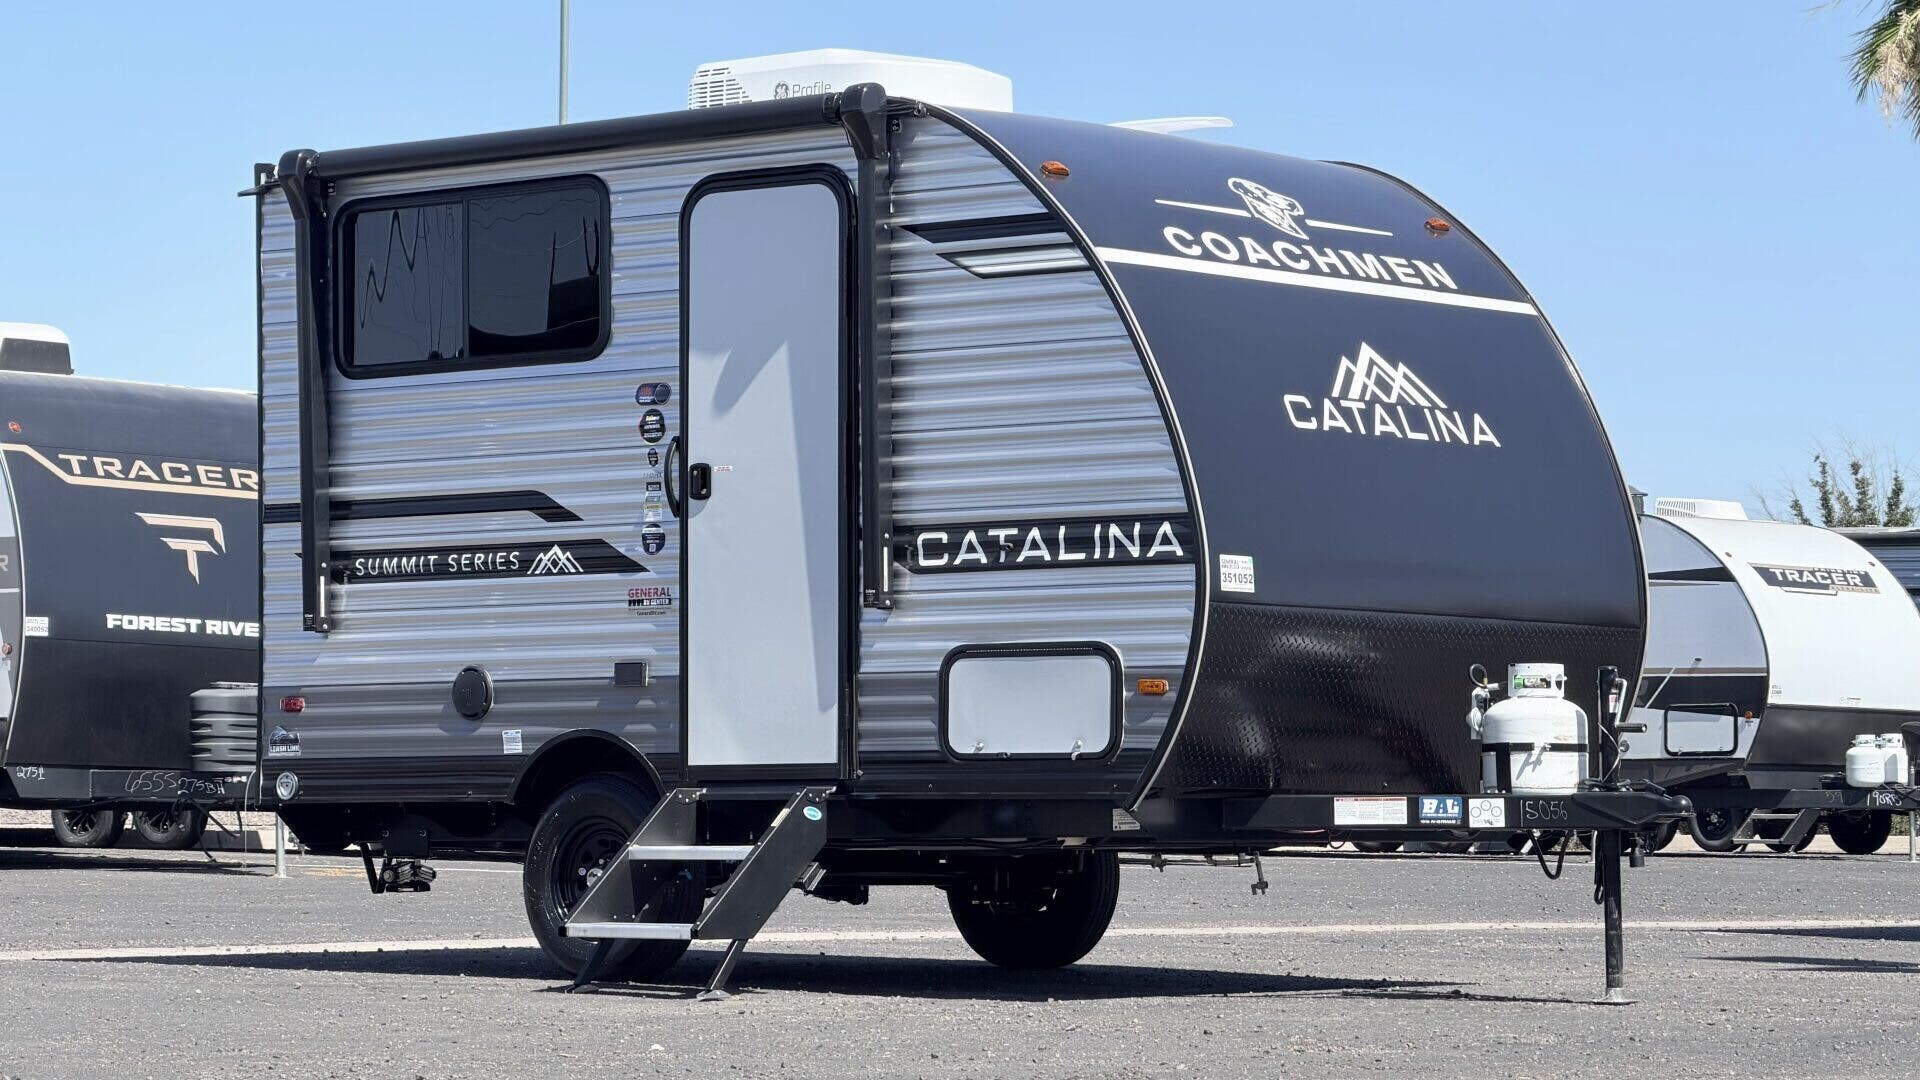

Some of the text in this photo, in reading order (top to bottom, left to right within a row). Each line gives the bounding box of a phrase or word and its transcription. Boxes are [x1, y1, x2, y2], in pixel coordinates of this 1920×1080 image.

[793, 80, 832, 98] Profile
[1163, 226, 1458, 290] COACHMEN
[1283, 394, 1501, 447] CATALINA
[58, 453, 258, 490] TRACER
[917, 520, 1184, 567] CATALINA
[355, 551, 520, 577] SUMMIT SERIES
[1222, 572, 1254, 584] 351052
[1769, 568, 1864, 586] TRACER
[628, 587, 671, 598] GENERAL
[106, 614, 259, 637] FOREST RIVE
